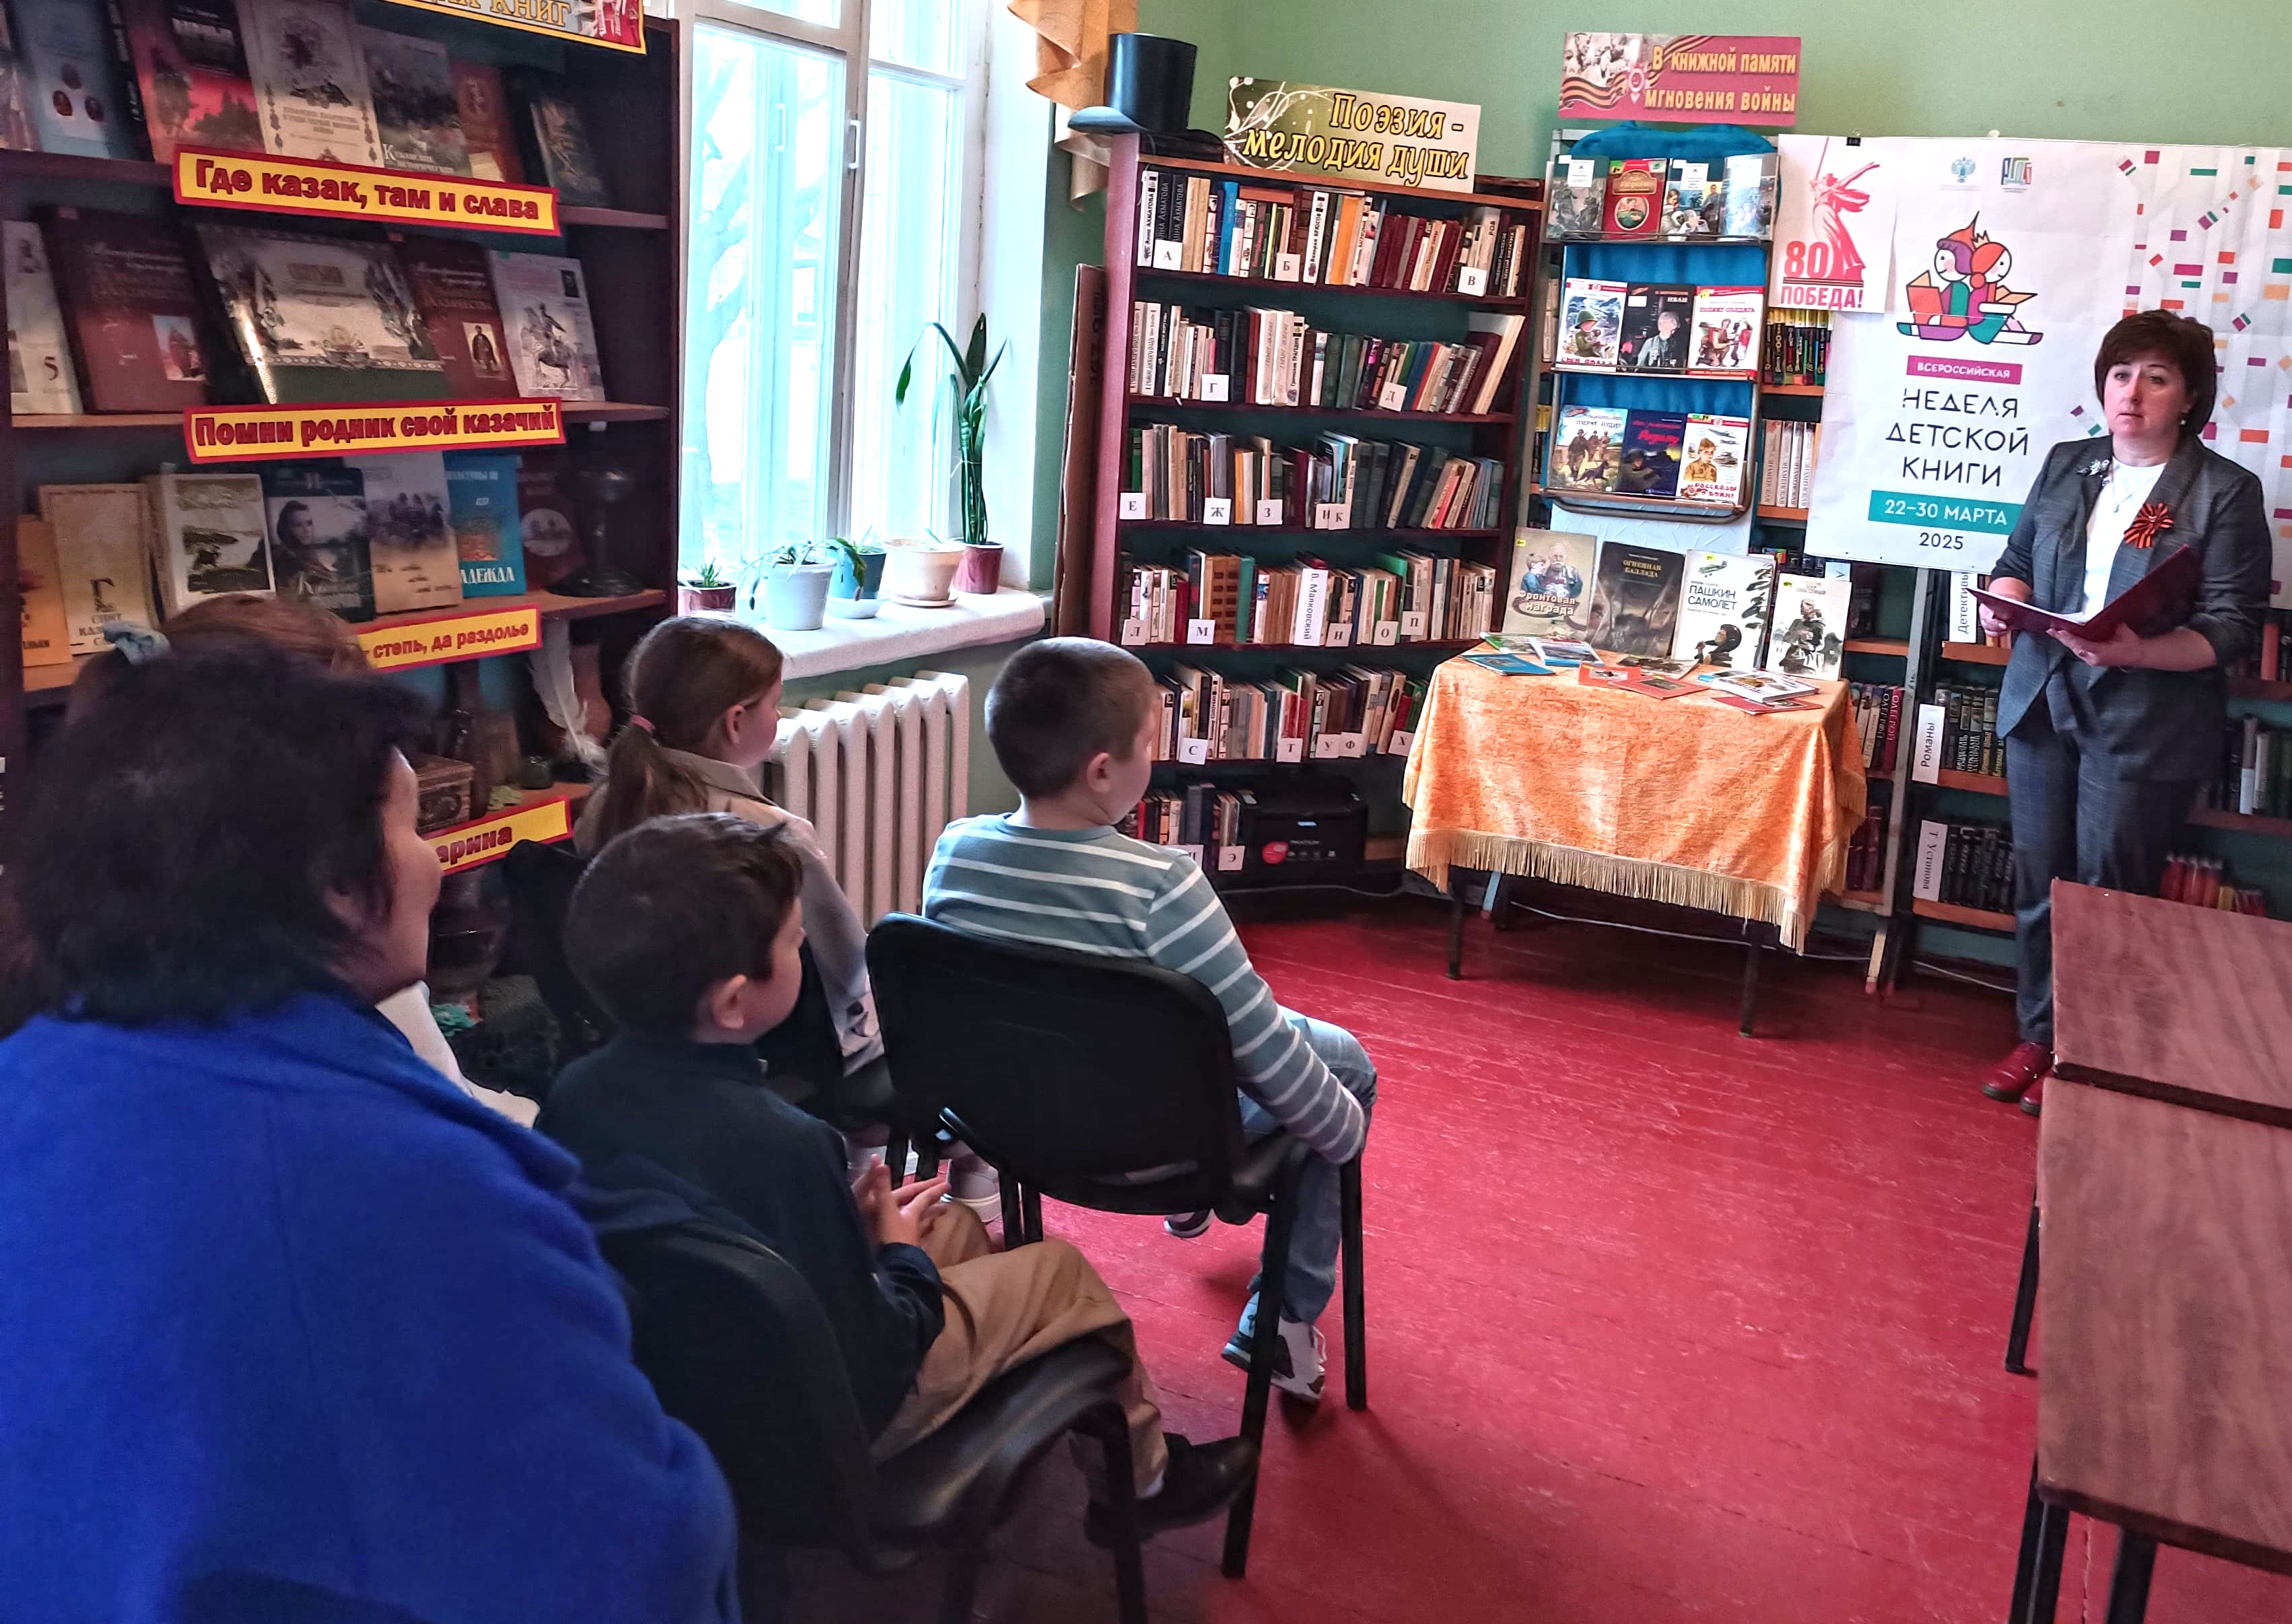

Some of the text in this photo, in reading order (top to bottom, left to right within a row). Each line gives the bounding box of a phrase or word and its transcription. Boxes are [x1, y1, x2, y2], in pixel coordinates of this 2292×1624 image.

[1330, 93, 1446, 139] Поэзия
[1242, 128, 1470, 187] мелодия души
[195, 159, 539, 220] Где казак, там и слава
[1163, 250, 1172, 261] А
[1784, 240, 1829, 279] 80
[1283, 261, 1291, 271] Б
[1467, 275, 1476, 286] В
[1780, 285, 1864, 310] ПОБЕДА!
[1917, 362, 2011, 378] ВСЕРОССИЙСКАЯ
[1209, 382, 1217, 393] Г
[1384, 390, 1394, 403] Д
[1903, 388, 2019, 418] НЕДЕЛЯ
[195, 405, 556, 447] Помни родник свой казачий
[1885, 422, 2029, 456] ДЕТСКОЙ
[1903, 456, 2002, 487] КНИГИ
[1128, 501, 1137, 511] Е
[1211, 507, 1224, 517] Ж
[1335, 512, 1345, 522] К
[1945, 506, 2008, 526] МАРТА
[1919, 532, 1964, 550] 2025
[461, 567, 515, 584] АДЕЖДА
[1689, 585, 1736, 599] ПАШКИН
[1958, 572, 1969, 634] Детективы
[1410, 617, 1419, 627] П
[1130, 627, 1139, 637] Л
[1196, 627, 1208, 636] М
[373, 640, 428, 658] степь,
[432, 634, 452, 652] да
[457, 623, 529, 649] раздолье
[1189, 745, 1198, 755] С
[1287, 743, 1295, 753] Т
[1346, 740, 1355, 749] Ф
[1921, 722, 1935, 767] Романы
[436, 826, 512, 866] арина
[1227, 854, 1236, 862] Э
